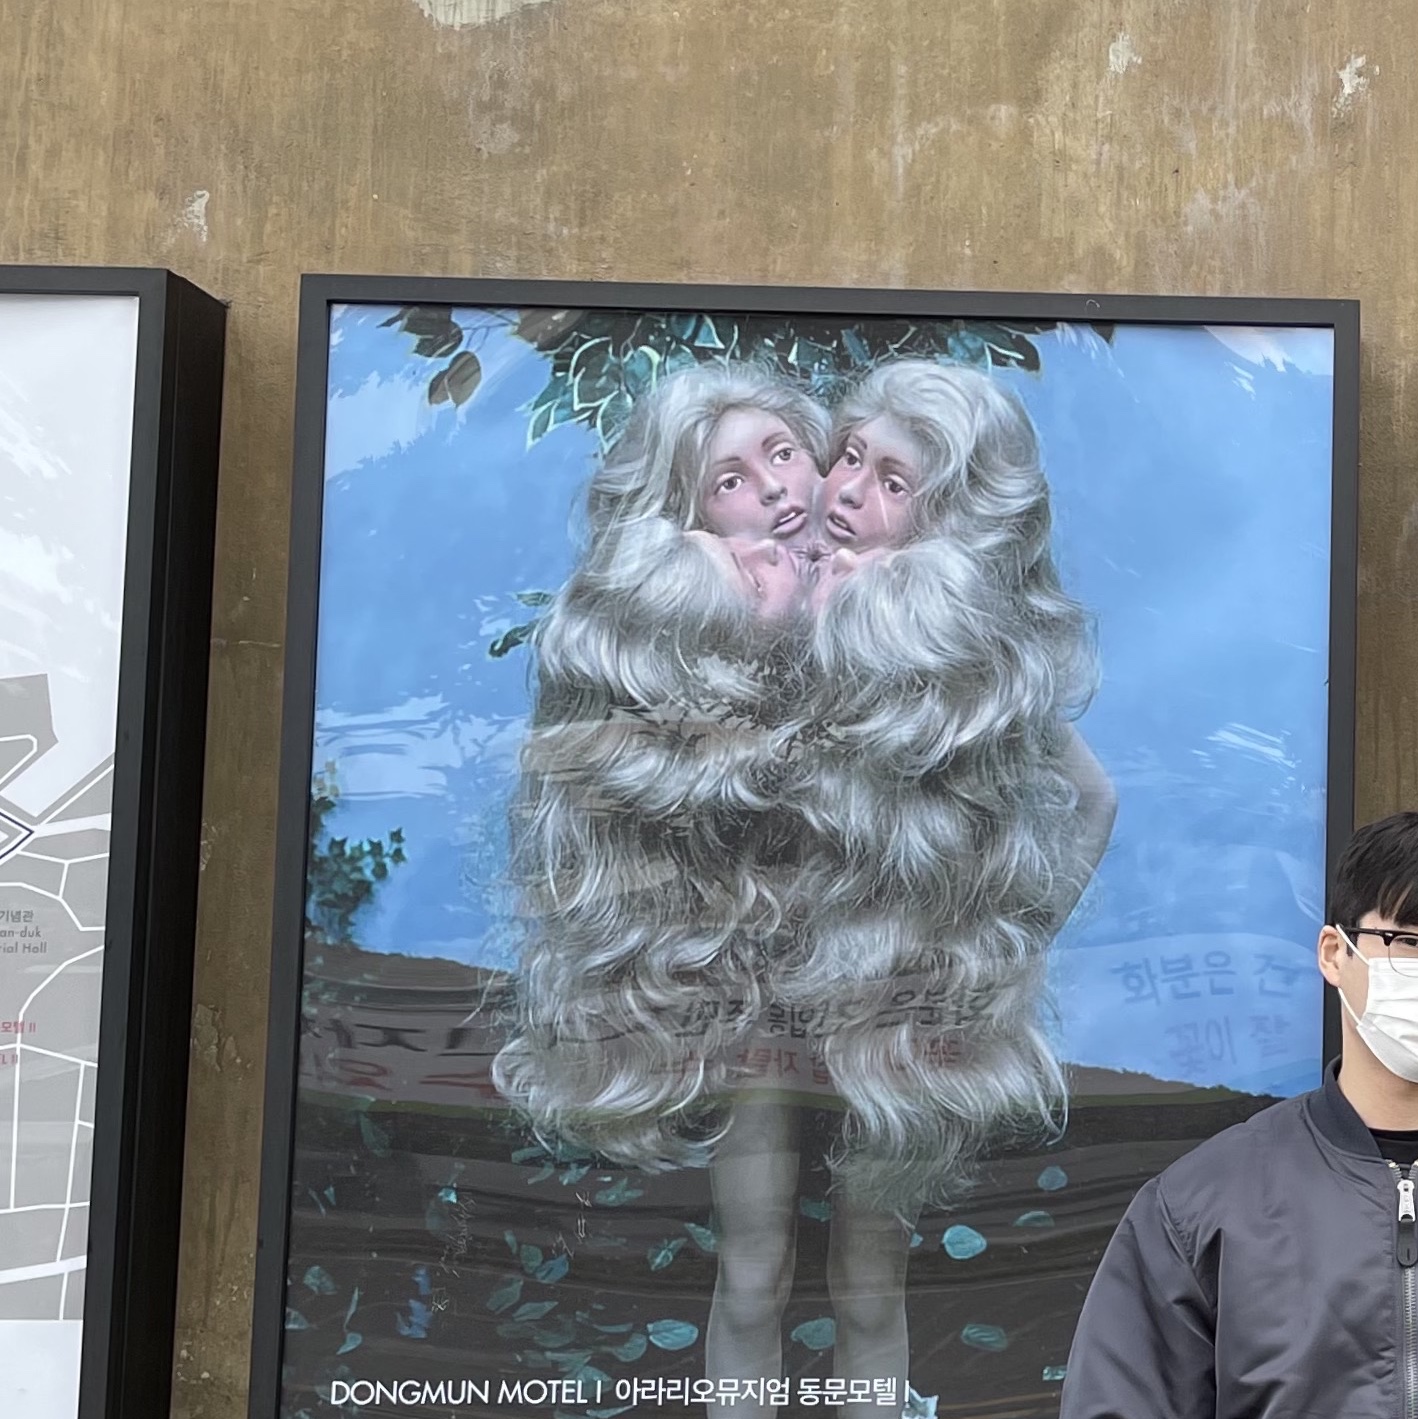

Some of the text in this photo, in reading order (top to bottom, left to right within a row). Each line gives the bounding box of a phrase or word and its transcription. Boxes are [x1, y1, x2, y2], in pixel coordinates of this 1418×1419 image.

[0, 941, 48, 954] ial Hall
[331, 1380, 489, 1407] DONGMUN
[498, 1380, 587, 1404] MOTEL
[616, 1377, 789, 1408] 아라리오뮤지엄
[797, 1377, 896, 1406] 동문모텔
